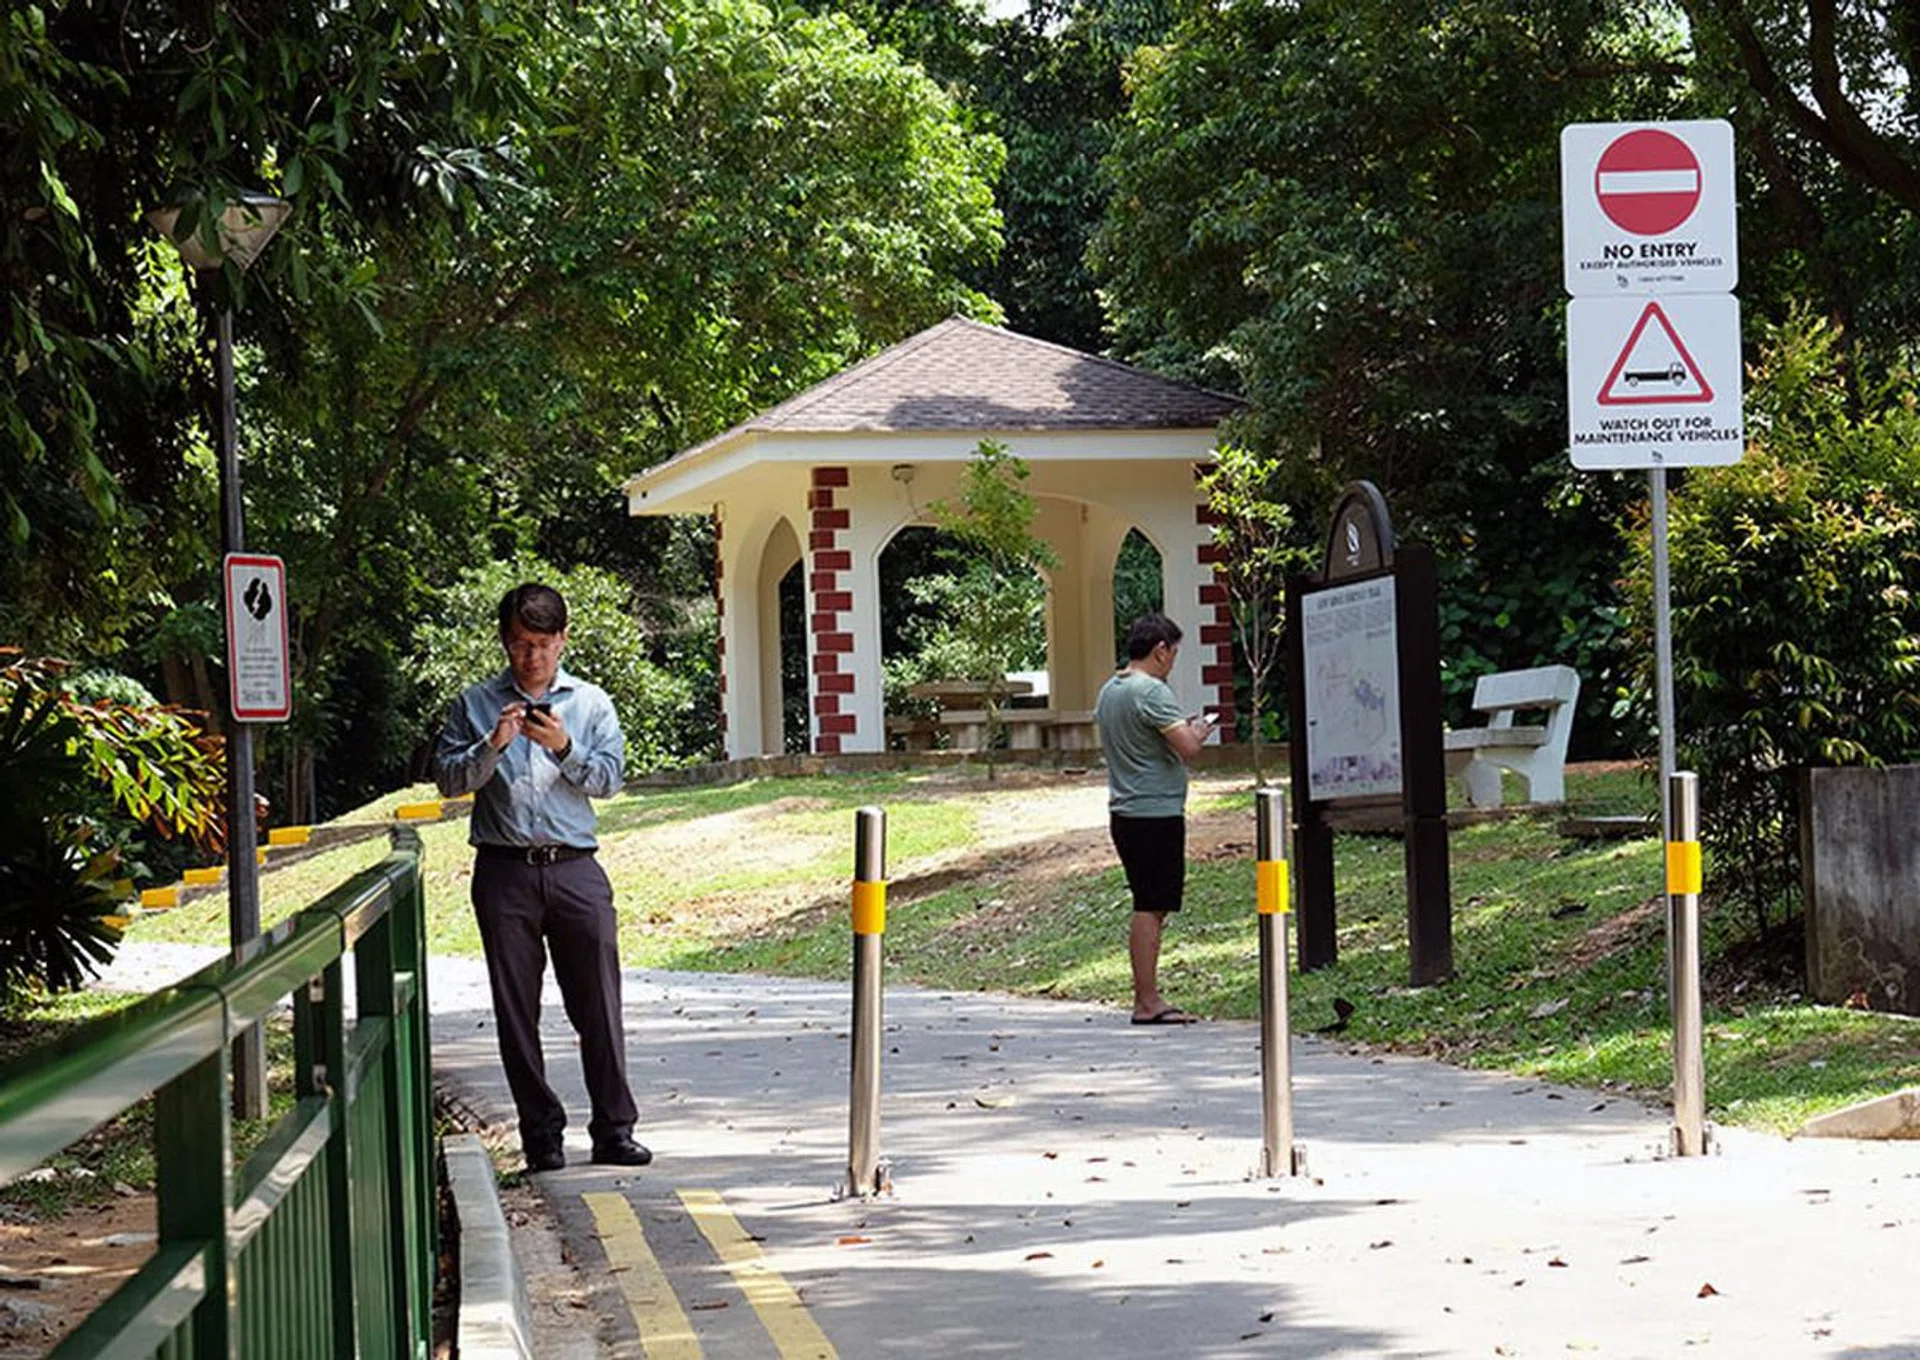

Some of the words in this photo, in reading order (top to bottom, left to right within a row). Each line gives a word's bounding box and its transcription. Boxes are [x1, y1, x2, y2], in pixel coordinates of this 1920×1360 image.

[1604, 244, 1634, 259] NO
[1640, 242, 1697, 258] ENTRY
[1580, 261, 1614, 270] EXCEPT
[1617, 259, 1677, 268] AUTHORISED
[1680, 258, 1722, 267] VEHICLES
[1600, 419, 1648, 431] WATCH
[1652, 417, 1680, 429] OUT
[1685, 416, 1712, 428] FOR
[1574, 431, 1673, 444] MAINTENANCE
[1678, 428, 1739, 442] VEHICLES
